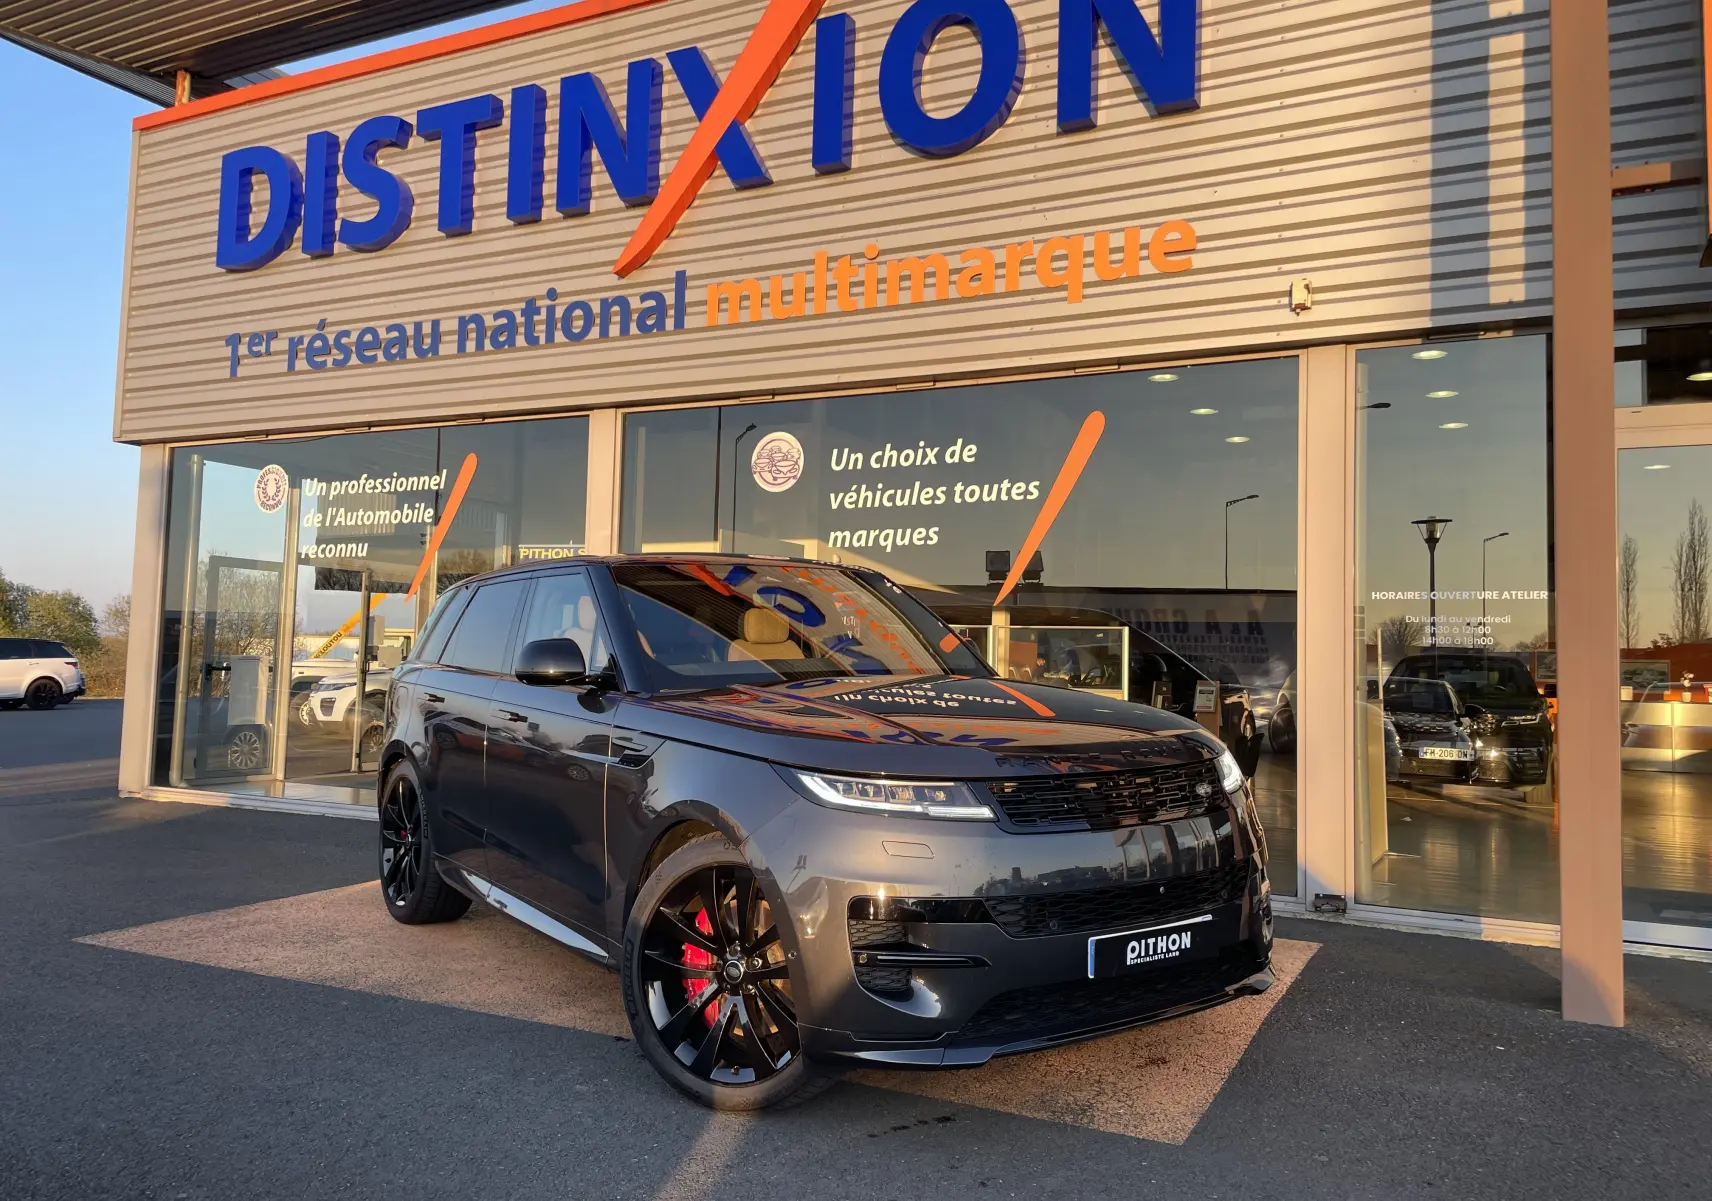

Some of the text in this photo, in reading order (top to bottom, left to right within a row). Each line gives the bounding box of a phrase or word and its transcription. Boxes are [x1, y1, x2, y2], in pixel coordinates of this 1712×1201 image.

[216, 0, 1201, 278] DISTINXION
[224, 219, 1198, 378] 1er réseau national multimarque
[830, 438, 978, 471] Un choix de
[305, 469, 448, 501] Un professionnel
[829, 478, 1041, 510] véhicules toutes
[302, 502, 435, 528] de l'Automobile
[301, 542, 369, 559] reconnu
[828, 526, 940, 553] marques
[519, 548, 574, 559] PITHON
[1371, 590, 1549, 600] HORAIRES OUVERTURE ATELIER
[1405, 615, 1419, 623] Du
[1421, 614, 1447, 623] lundi
[1464, 614, 1511, 624] vendredi
[1424, 626, 1451, 634] 8h30
[1462, 626, 1491, 634] 12h00
[1422, 636, 1451, 645] 14h00
[1463, 636, 1494, 645] 18h00
[1126, 931, 1192, 966] PITHON
[1130, 953, 1165, 965] SPECIALISTE
